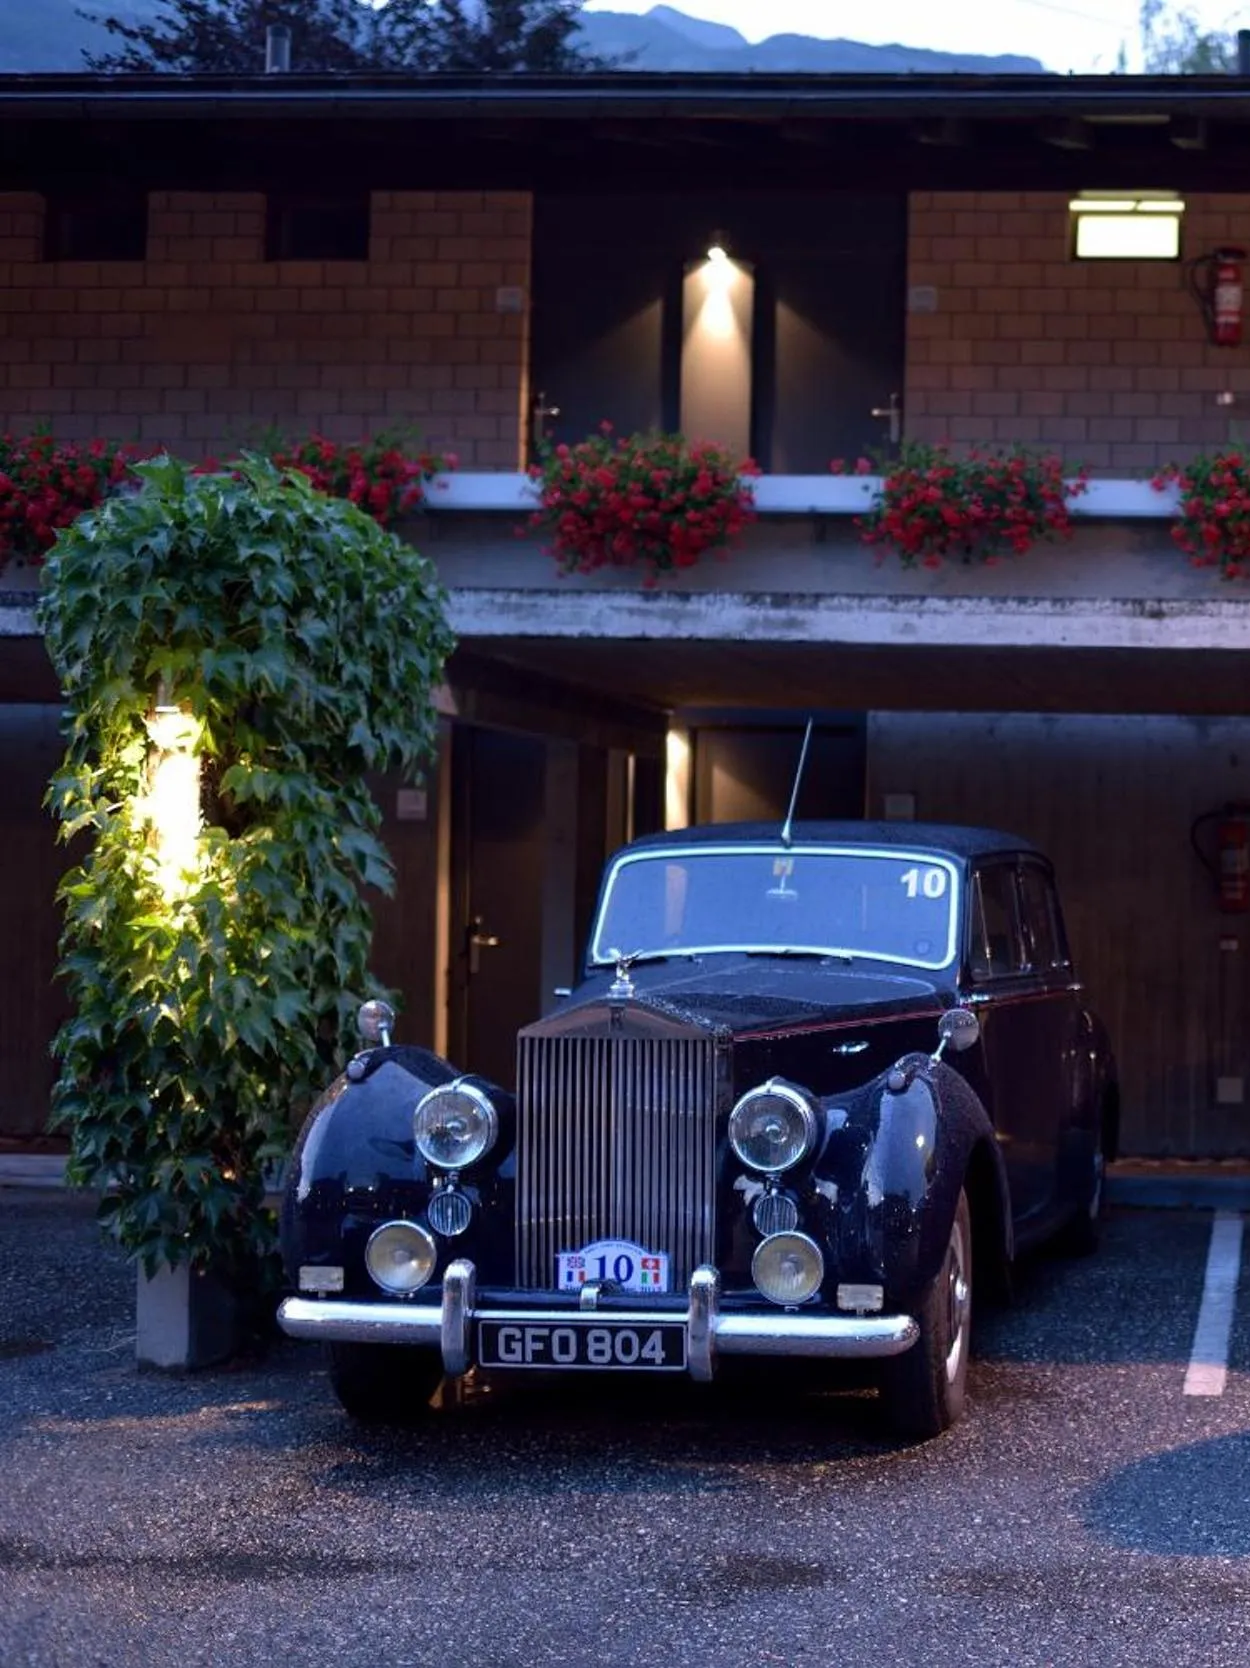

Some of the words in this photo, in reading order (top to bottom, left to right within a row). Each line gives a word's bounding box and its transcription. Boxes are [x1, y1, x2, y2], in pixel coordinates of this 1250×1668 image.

[901, 868, 947, 899] 10
[592, 1253, 634, 1283] 10
[498, 1327, 577, 1363] GFO
[587, 1329, 666, 1365] 804
